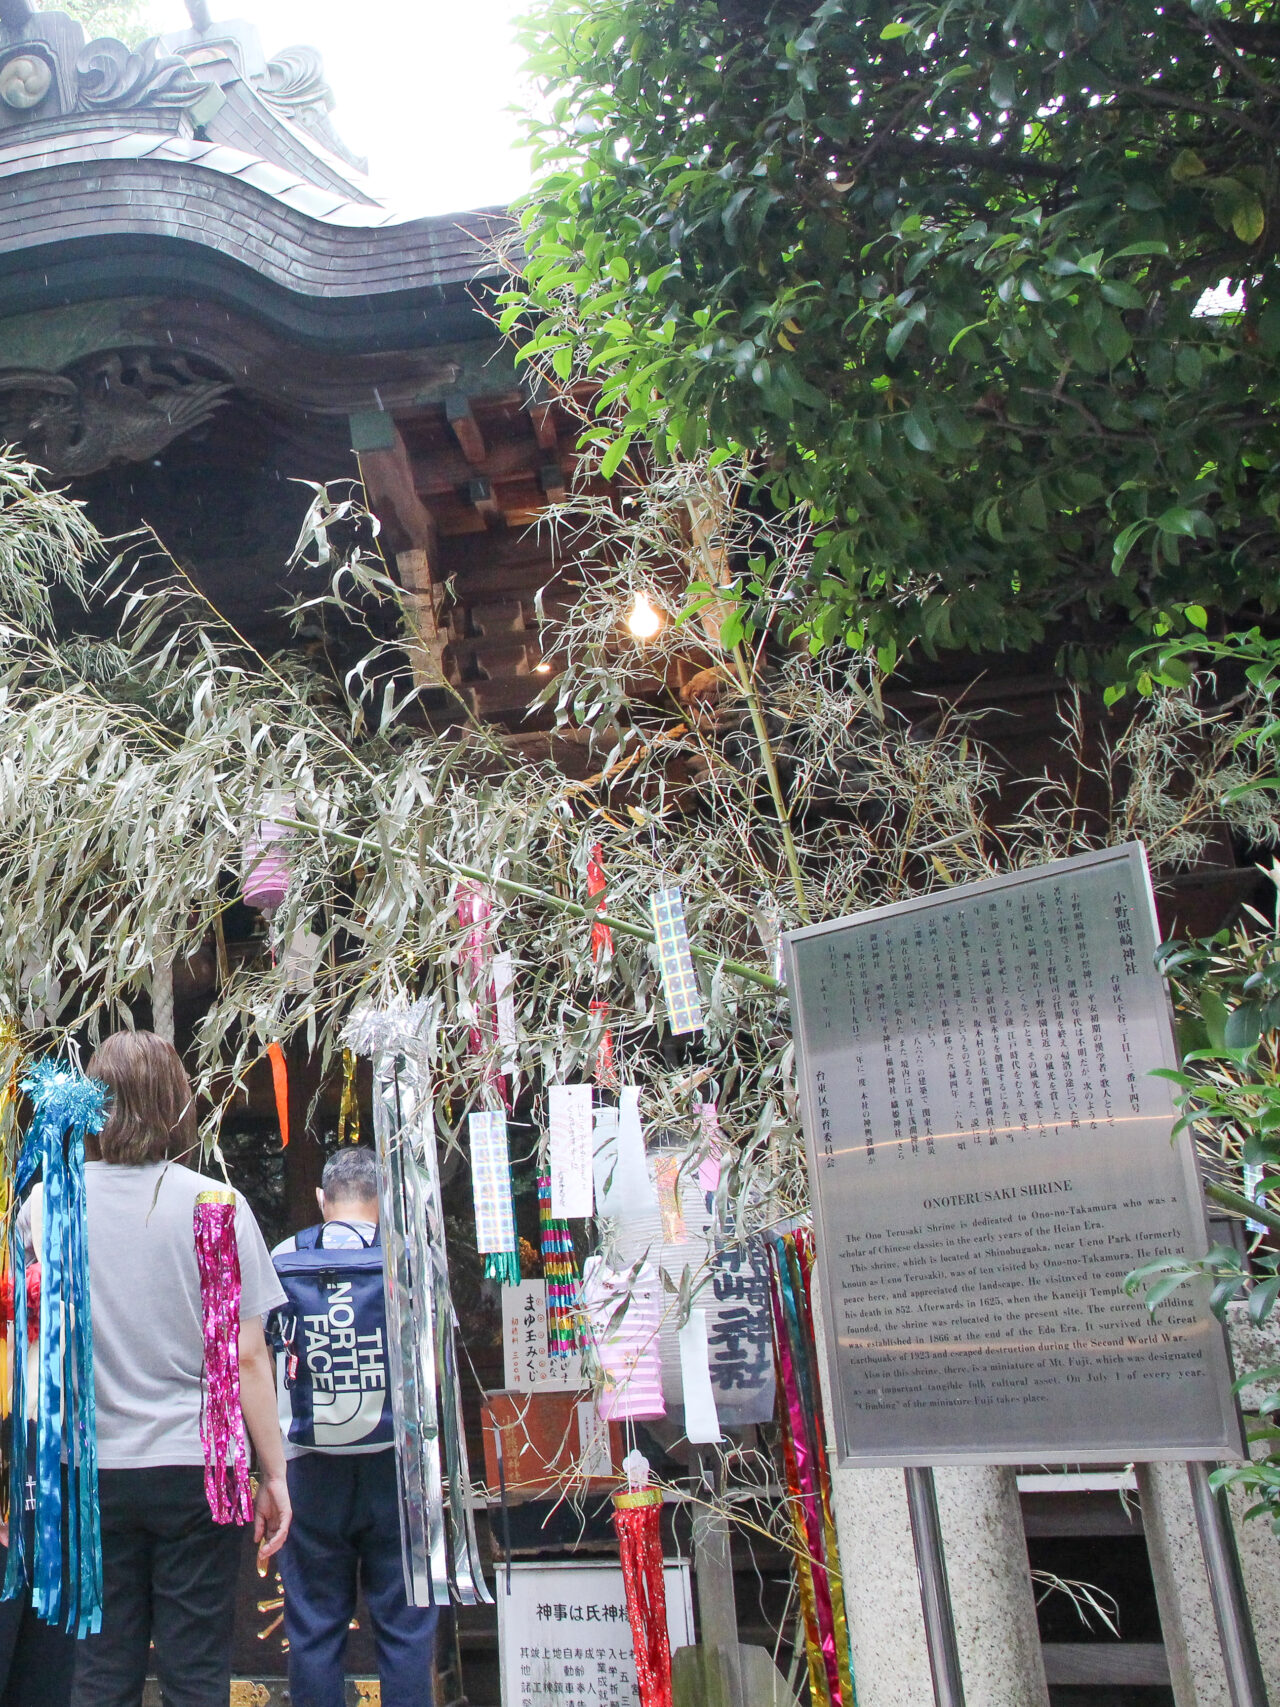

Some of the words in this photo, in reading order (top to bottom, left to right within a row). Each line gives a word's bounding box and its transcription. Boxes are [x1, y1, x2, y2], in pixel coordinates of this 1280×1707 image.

[1111, 889, 1140, 977] 小野照崎神社
[815, 1070, 836, 1169] 台東区教育委員会
[923, 1187, 1016, 1210] ONOTERUSAKI
[1020, 1180, 1073, 1197] SHRINE
[846, 1232, 860, 1241] The
[865, 1229, 881, 1239] Ono
[886, 1224, 922, 1236] Terusaki
[927, 1220, 955, 1232] Shrine
[972, 1214, 1013, 1226] dedicated
[1031, 1201, 1117, 1220] Ono-no-Takamura
[1123, 1198, 1142, 1209] who
[1148, 1198, 1165, 1206] was
[851, 1262, 867, 1271] This
[903, 1255, 926, 1266] which
[940, 1251, 969, 1262] located
[1054, 1242, 1075, 1250] near
[1079, 1236, 1104, 1248] Ueno
[1108, 1233, 1131, 1245] Park
[868, 1245, 877, 1254] of
[878, 1241, 911, 1253] Chinese
[913, 1238, 943, 1249] classics
[957, 1235, 971, 1244] the
[973, 1232, 994, 1245] early
[999, 1232, 1022, 1242] years
[1036, 1226, 1051, 1236] the
[1054, 1222, 1081, 1234] Heian
[1084, 1219, 1104, 1231] Era.
[997, 1261, 1026, 1272] visited
[1043, 1250, 1133, 1268] Ono-no-Takamura.
[1137, 1248, 1151, 1259] He
[1154, 1246, 1172, 1257] felt
[844, 1295, 864, 1304] peace
[892, 1288, 907, 1298] and
[910, 1284, 958, 1298] appreciated
[961, 1282, 975, 1292] the
[1045, 1271, 1088, 1284] visitnved
[1105, 1271, 1129, 1279] come
[845, 1308, 857, 1317] his
[859, 1306, 881, 1316] death
[895, 1303, 913, 1313] 852.
[1007, 1293, 1030, 1304] when
[1034, 1292, 1048, 1302] the
[1052, 1288, 1087, 1302] Kaneiji
[1090, 1285, 1128, 1299] Temple
[885, 1320, 898, 1329] the
[901, 1318, 928, 1328] shrine
[951, 1313, 989, 1324] relocated
[1006, 1310, 1020, 1320] the
[1024, 1308, 1058, 1321] present
[1063, 1306, 1083, 1316] site.
[1089, 1304, 1105, 1314] The
[929, 1332, 949, 1342] 1866
[966, 1330, 980, 1339] the
[984, 1328, 1001, 1338] end
[1019, 1326, 1033, 1336] the
[1038, 1324, 1055, 1334] Edo
[1060, 1323, 1080, 1333] Era.
[1098, 1318, 1141, 1330] survived
[1146, 1316, 1162, 1327] the
[1167, 1314, 1197, 1325] Great
[303, 1313, 334, 1392] FACE
[326, 1281, 361, 1392] NORTH
[524, 1293, 539, 1383] まゆ玉みくじ
[910, 1349, 930, 1359] 1923
[932, 1348, 948, 1358] and
[950, 1346, 983, 1359] escaped
[985, 1342, 1035, 1354] destruction
[1038, 1340, 1069, 1353] during
[1072, 1339, 1087, 1349] the
[1090, 1336, 1124, 1348] Second
[1128, 1334, 1158, 1345] World
[1162, 1332, 1187, 1343] War.
[356, 1326, 387, 1391] THE
[893, 1367, 909, 1376] this
[990, 1360, 1034, 1370] miniature
[1096, 1354, 1124, 1364] which
[1148, 1349, 1203, 1364] designated
[928, 1380, 961, 1392] tangible
[969, 1379, 985, 1388] folk
[991, 1376, 1028, 1387] cultural
[1066, 1374, 1080, 1383] On
[1086, 1372, 1107, 1384] July
[1143, 1372, 1170, 1381] every
[915, 1398, 925, 1407] the
[974, 1395, 994, 1406] Fuji
[1023, 1392, 1049, 1404] place.
